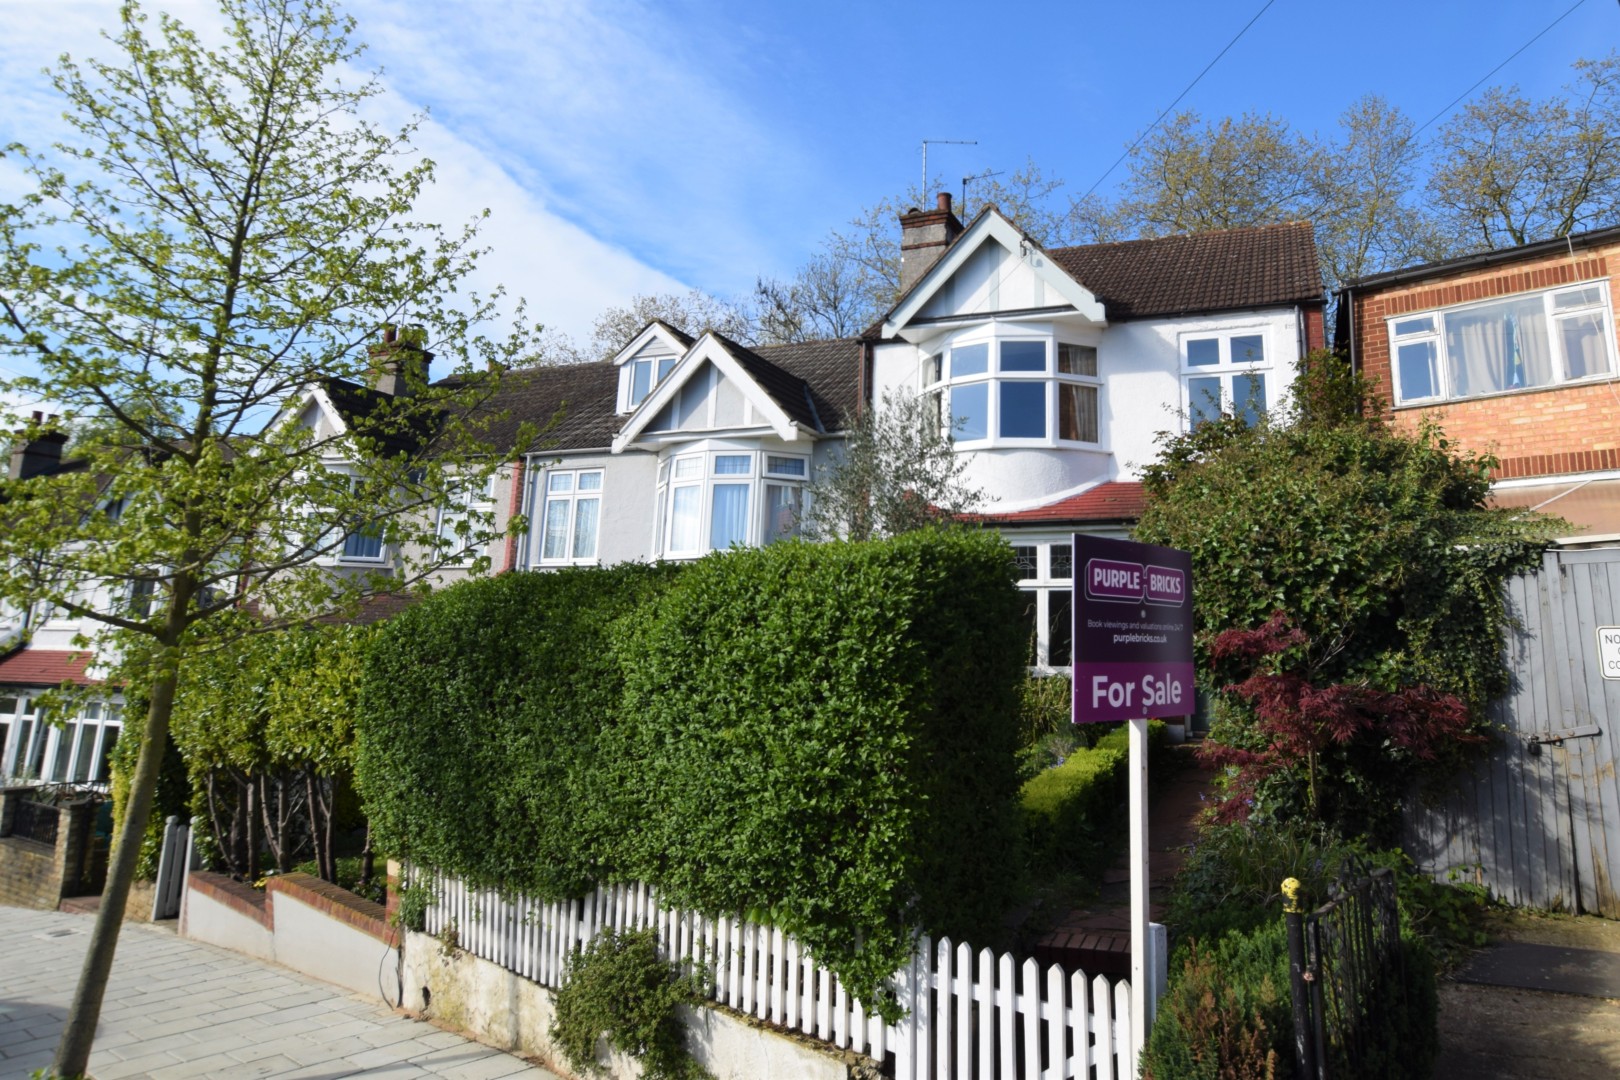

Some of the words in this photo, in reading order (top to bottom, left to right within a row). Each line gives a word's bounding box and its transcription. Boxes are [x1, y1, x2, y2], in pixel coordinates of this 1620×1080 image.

[1094, 568, 1140, 590] PURPLE
[1150, 574, 1181, 594] BRICKS
[1087, 619, 1102, 628] Book
[1104, 621, 1128, 630] viewings
[1114, 633, 1167, 643] purplebricks.co.uk
[1092, 675, 1136, 708] For
[1142, 673, 1181, 706] Sale
